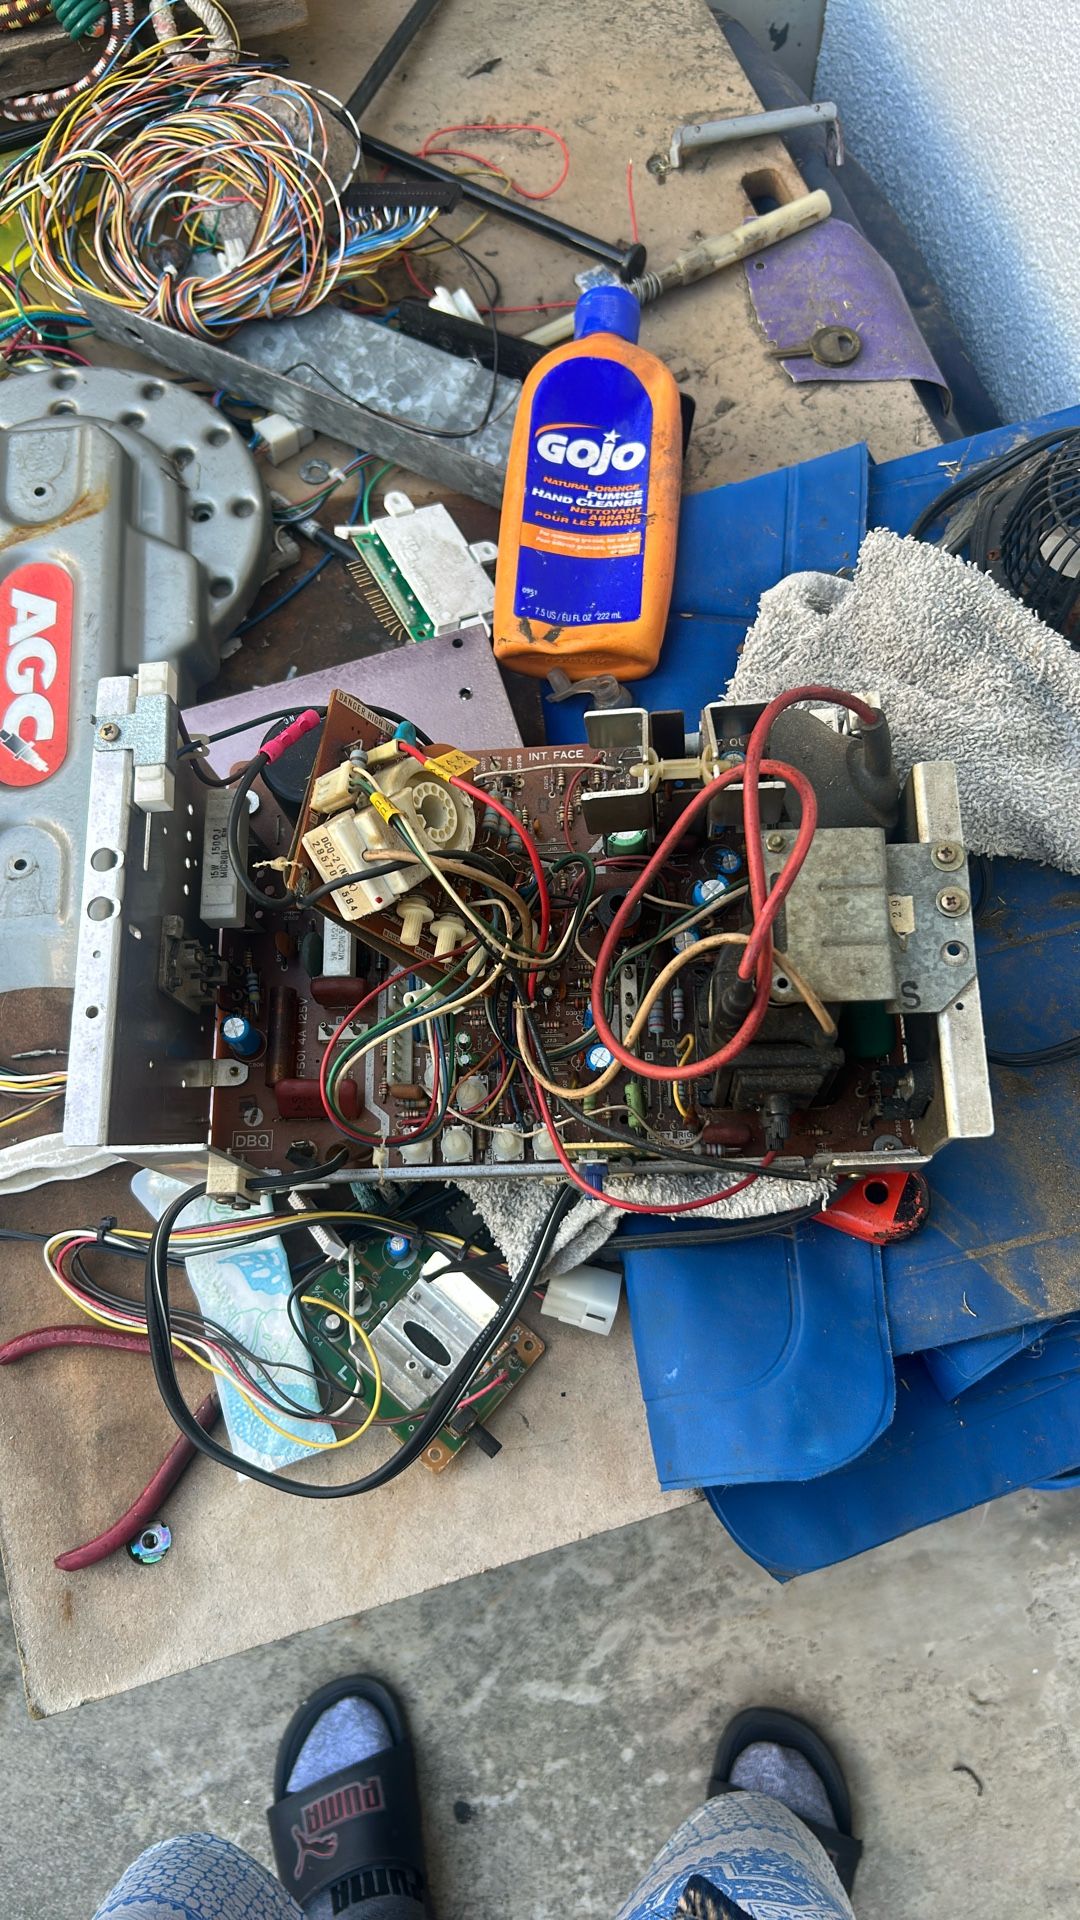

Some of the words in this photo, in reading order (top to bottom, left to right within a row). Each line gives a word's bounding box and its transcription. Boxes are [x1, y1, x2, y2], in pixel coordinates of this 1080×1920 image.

[537, 430, 646, 476] GOJO
[543, 476, 590, 491] NATURAL
[595, 484, 640, 492] ORANGE
[531, 488, 573, 504] HAND
[575, 498, 643, 508] CLEANER
[586, 490, 643, 500] PUMICE
[570, 506, 642, 515] NETTOYANT
[535, 511, 569, 523] POUR
[572, 519, 596, 527] LES
[599, 518, 642, 527] MAINS
[535, 607, 545, 617] 7.5
[546, 610, 557, 620] US
[572, 614, 581, 622] FL
[582, 613, 592, 621] OZ
[596, 612, 610, 621] 222
[610, 611, 622, 619] mL
[3, 588, 58, 741] AGC
[338, 692, 366, 716] DANGER
[367, 712, 384, 728] HIGH
[553, 749, 584, 759] FACE
[211, 864, 219, 879] 15W
[900, 980, 921, 1009] S
[299, 998, 309, 1024] 125V
[298, 1030, 307, 1045] 4A
[235, 1134, 270, 1149] DBQ
[303, 1777, 384, 1834] PUMA
